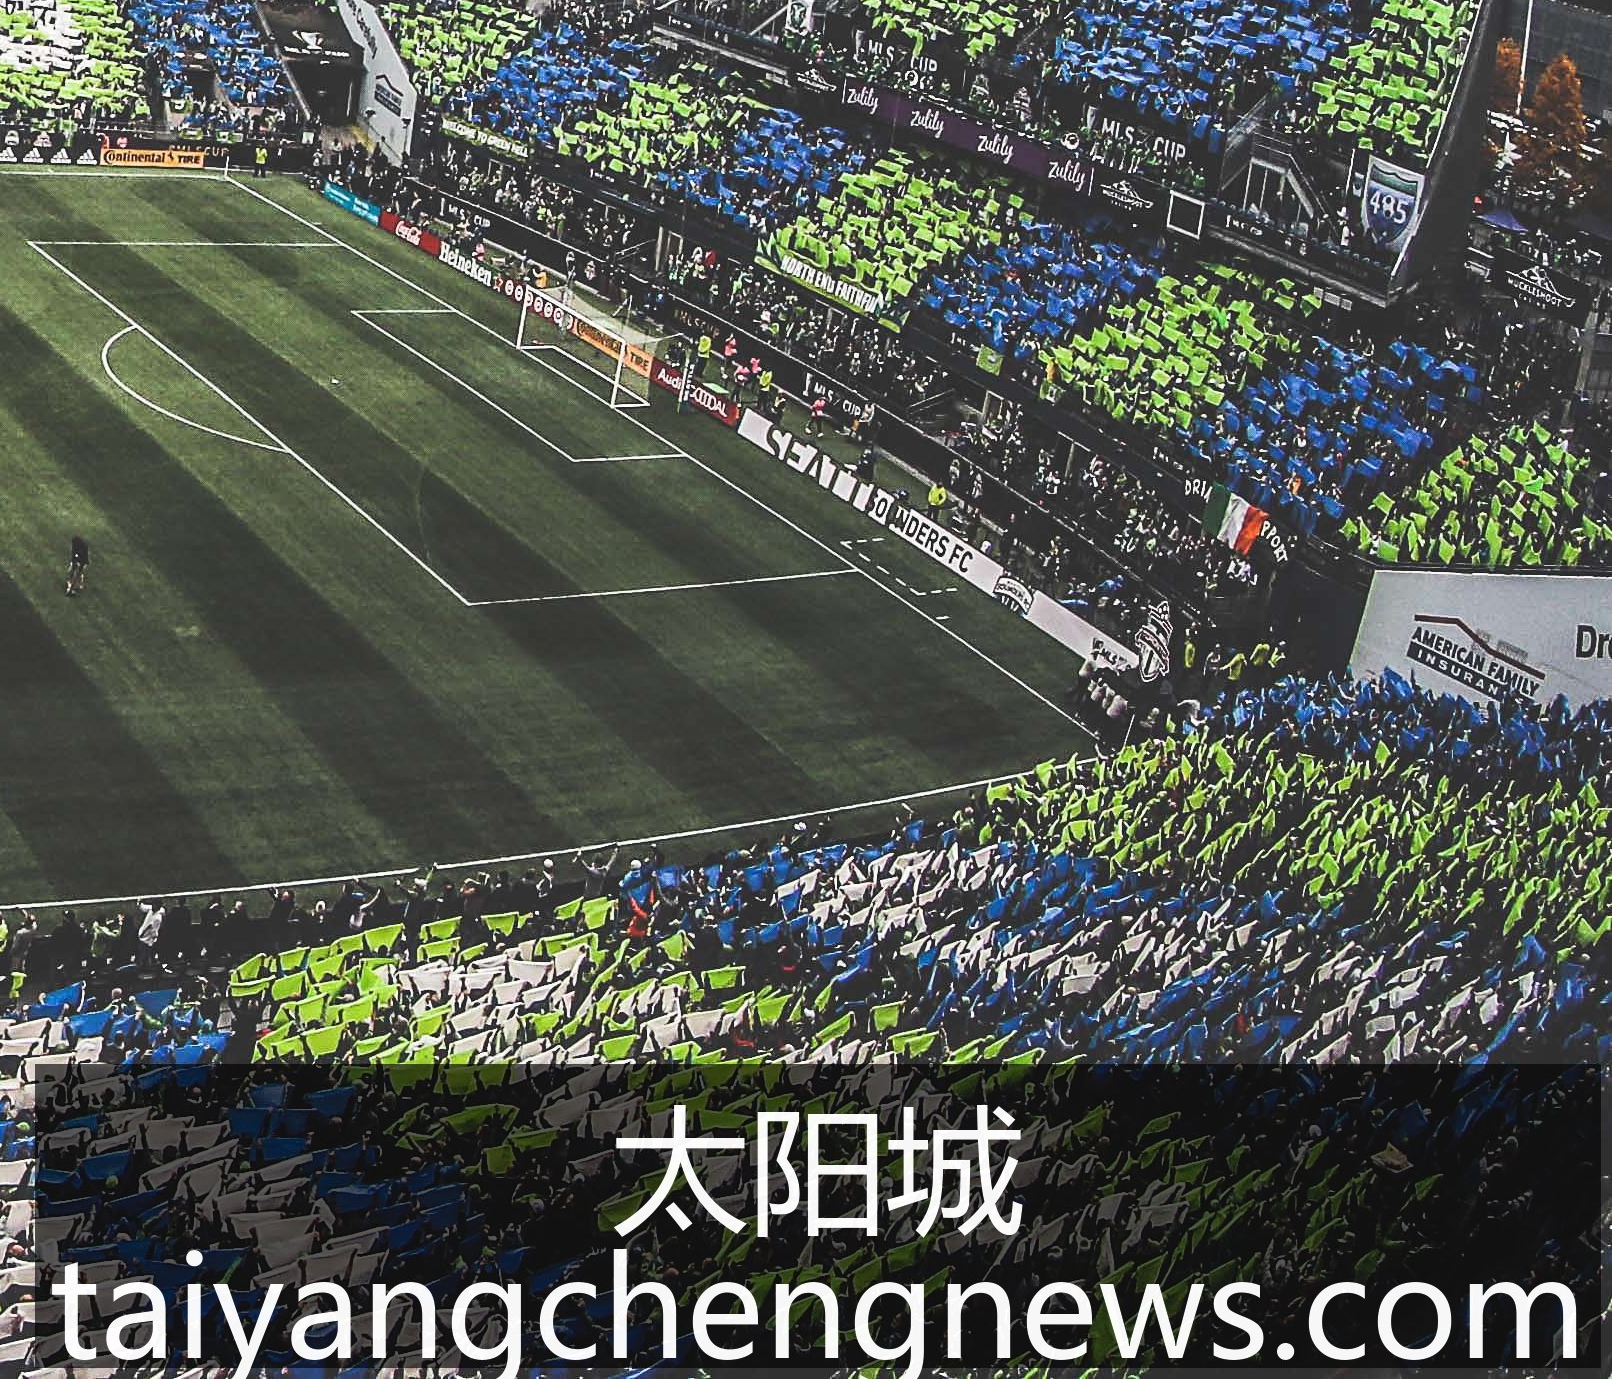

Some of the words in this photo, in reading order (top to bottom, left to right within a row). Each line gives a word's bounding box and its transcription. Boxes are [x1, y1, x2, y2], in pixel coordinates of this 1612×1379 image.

[103, 150, 165, 164] Continental
[177, 155, 201, 165] TIRE
[1101, 120, 1135, 145] MLS
[1152, 137, 1186, 162] CUP
[1368, 189, 1408, 225] 485
[439, 239, 492, 287] Heineken
[658, 368, 683, 389] Audi
[948, 548, 974, 574] FC
[1412, 626, 1484, 674] AMERICAN
[1488, 661, 1540, 697] FAMILY
